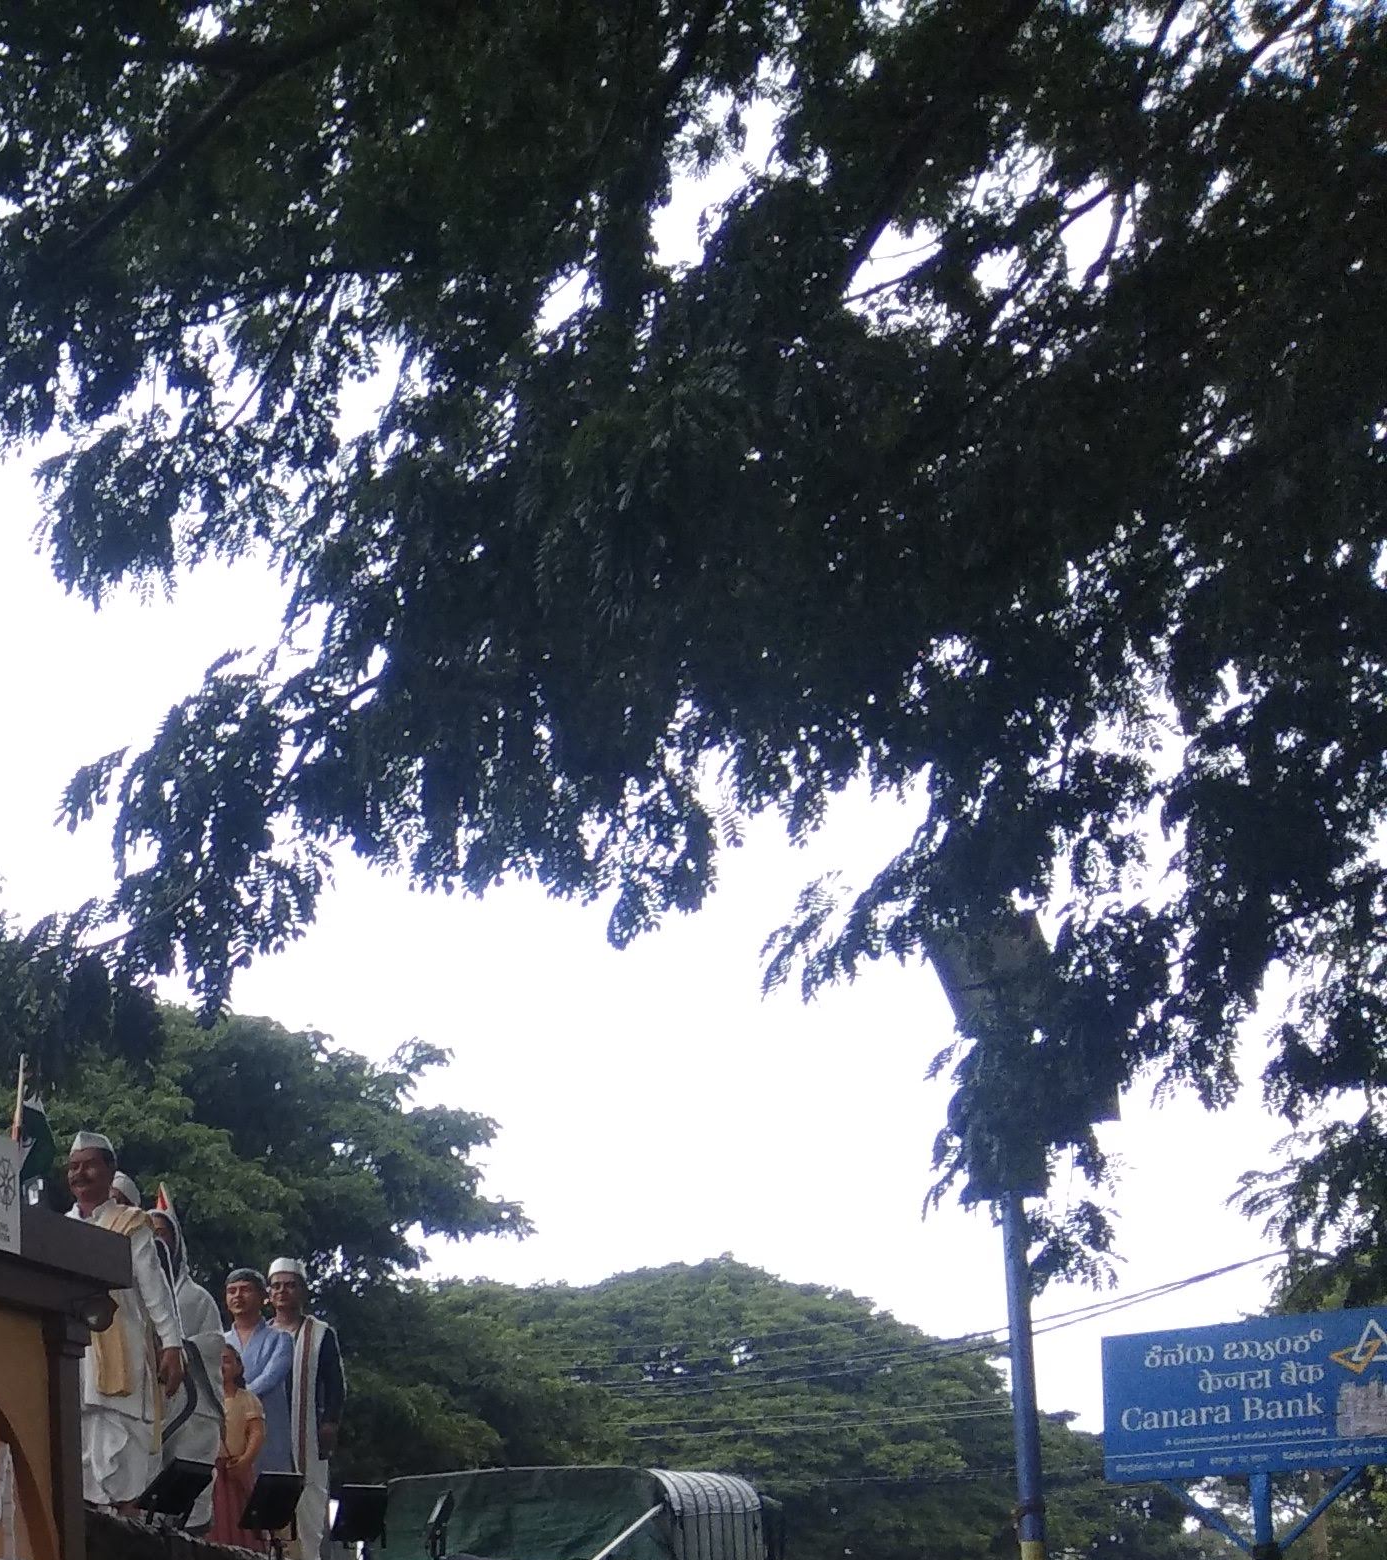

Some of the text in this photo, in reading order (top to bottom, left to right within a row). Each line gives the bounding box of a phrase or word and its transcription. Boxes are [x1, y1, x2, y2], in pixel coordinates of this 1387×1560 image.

[1121, 1392, 1325, 1432] Canara Bank
[1243, 1431, 1267, 1440] India
